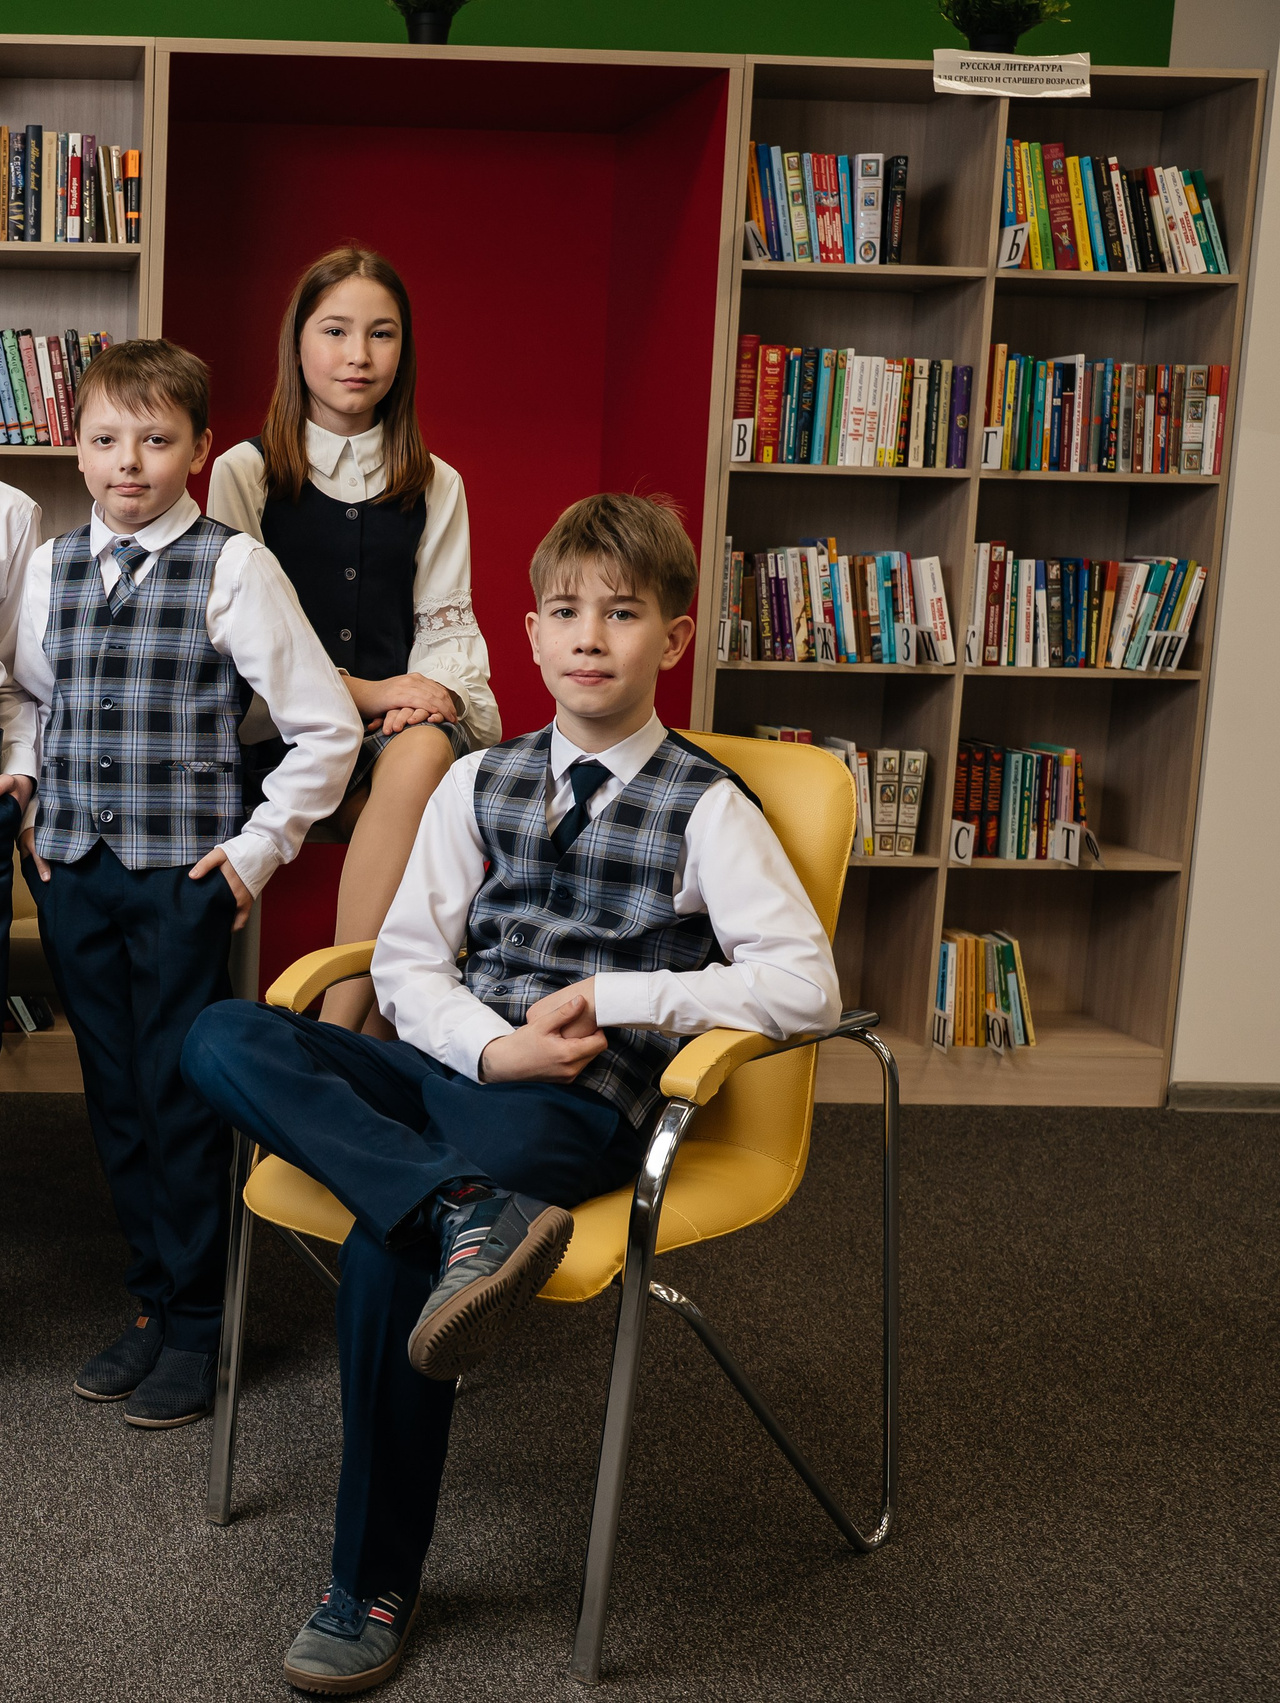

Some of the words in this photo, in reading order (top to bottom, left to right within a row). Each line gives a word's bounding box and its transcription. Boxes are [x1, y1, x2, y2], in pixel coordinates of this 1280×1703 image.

[954, 75, 993, 84] СРЕДНЕГО
[1003, 76, 1044, 85] СТАРШЕГО
[1046, 77, 1085, 85] ВОЗРАСТА
[960, 62, 1001, 71] РУССКАЯ
[1003, 63, 1063, 72] ЛИТЕРАТУРА
[13, 155, 23, 195] СЕРАФИНА
[70, 177, 79, 210] Брэдбери
[892, 208, 901, 247] ПОЖИРАТЕЛЬ
[1006, 227, 1024, 262] Б
[57, 384, 66, 403] ГЮГО
[58, 405, 69, 431] ВИКТОР
[735, 423, 748, 457] В
[983, 431, 998, 464] Г
[817, 627, 834, 661] Ж
[902, 628, 910, 661] З
[919, 630, 939, 662] И
[955, 827, 970, 860] С
[1062, 827, 1075, 860] Т
[986, 1015, 1003, 1048] Ю
